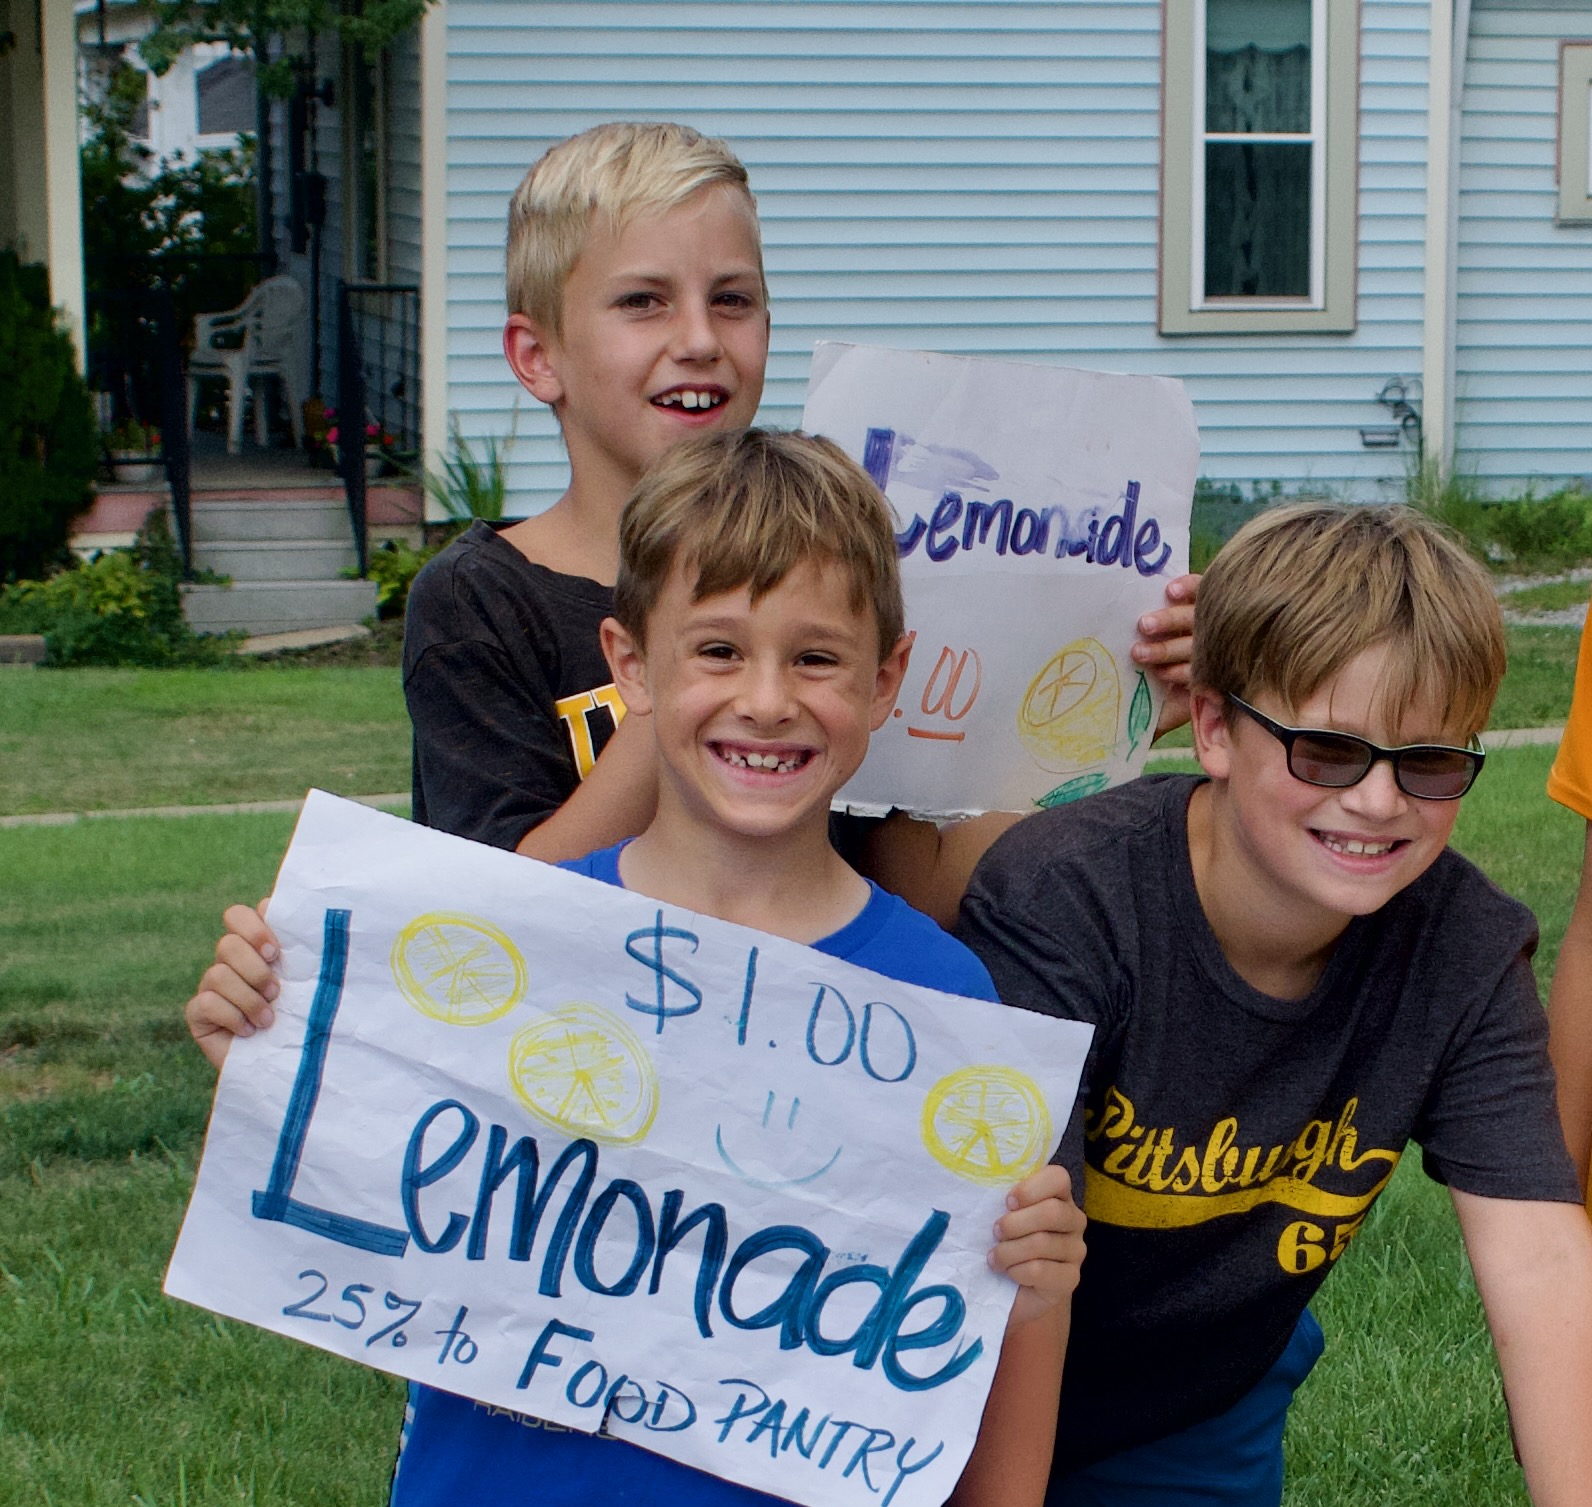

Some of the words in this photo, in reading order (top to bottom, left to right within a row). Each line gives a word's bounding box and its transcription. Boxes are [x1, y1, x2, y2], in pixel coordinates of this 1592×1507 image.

[863, 427, 1172, 577] Lemonade
[893, 630, 982, 721] .00
[625, 908, 918, 1083] $1.00
[251, 908, 983, 1391] Lemonade
[282, 1268, 422, 1349] 25%
[434, 1306, 480, 1366] to
